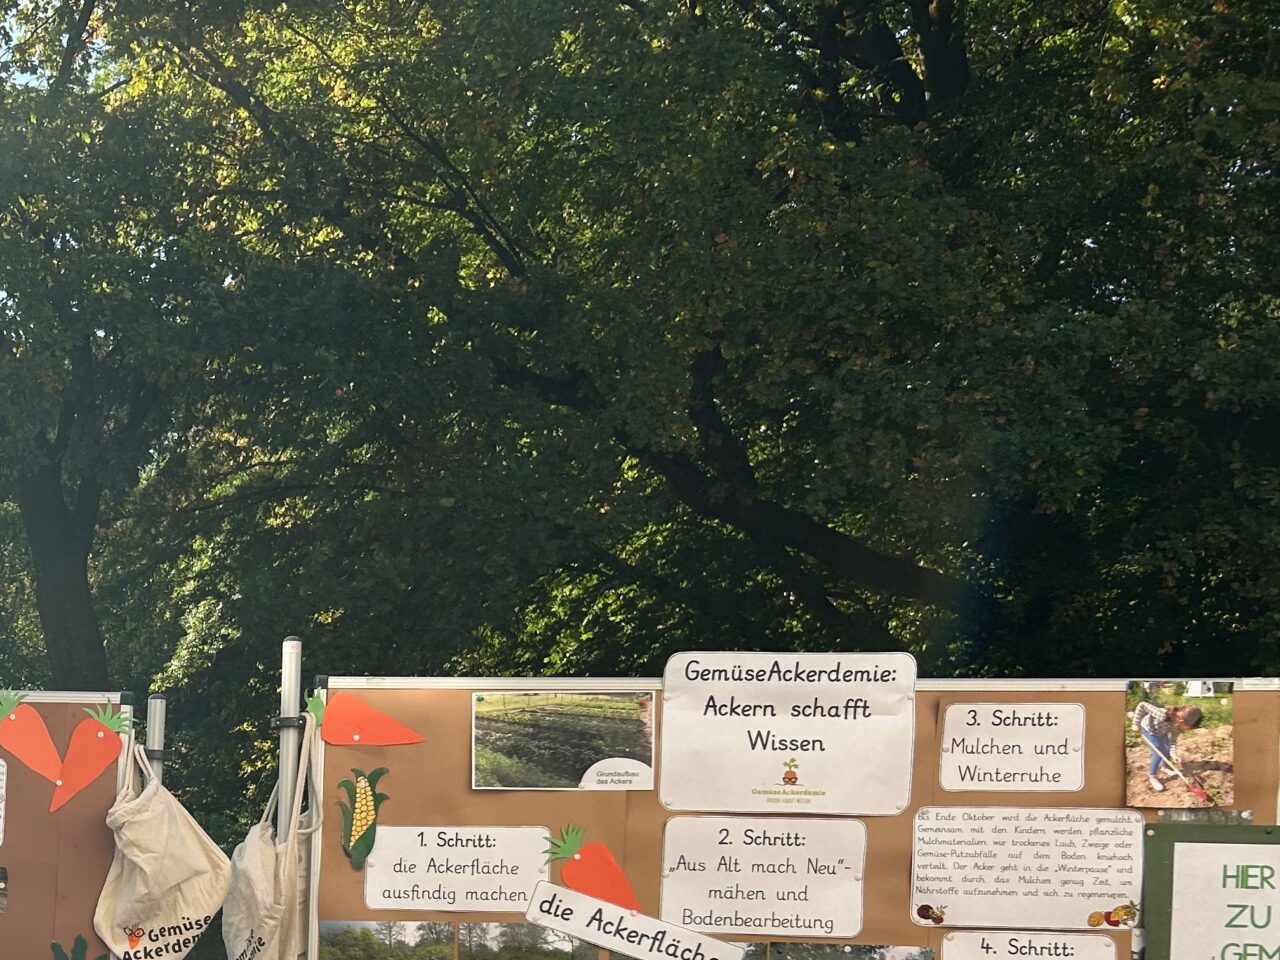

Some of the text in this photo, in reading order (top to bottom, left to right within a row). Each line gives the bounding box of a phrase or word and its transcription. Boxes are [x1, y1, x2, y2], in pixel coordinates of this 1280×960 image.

[685, 660, 896, 682] GemüseAckerdemie:
[703, 695, 872, 720] Ackern schafft
[966, 709, 1058, 727] 3. Schritt:
[747, 730, 825, 752] Wissen
[951, 737, 1069, 755] Mulchen und
[958, 765, 1061, 783] Winterruhe
[935, 812, 956, 821] Ende
[962, 812, 995, 821] Oktober
[1002, 813, 1019, 821] wird
[1025, 813, 1037, 821] die
[1044, 814, 1090, 823] Ackerfläche
[417, 831, 496, 848] 1. Schritt:
[718, 828, 806, 847] 2. Schritt:
[918, 824, 963, 833] Gemeinsam
[991, 826, 1007, 834] den
[1014, 825, 1046, 834] Kindern
[1053, 827, 1082, 835] werden
[1089, 827, 1134, 837] pflanzliche
[918, 837, 987, 846] Mulchmaterialien
[1012, 838, 1050, 847] trockenes
[1081, 839, 1110, 850] Zweige
[1114, 840, 1133, 848] oder
[393, 857, 519, 876] die Ackerfläche
[717, 855, 741, 873] Alt
[752, 857, 797, 874] mach
[1222, 864, 1276, 890] HIER
[382, 884, 528, 905] ausfindig machen
[709, 883, 809, 901] mähen und
[539, 893, 573, 921] die
[1224, 904, 1272, 929] ZU
[148, 915, 212, 943] Gemüse
[682, 908, 833, 934] Bodenbearbeitung
[981, 938, 1074, 957] 4. Schritt:
